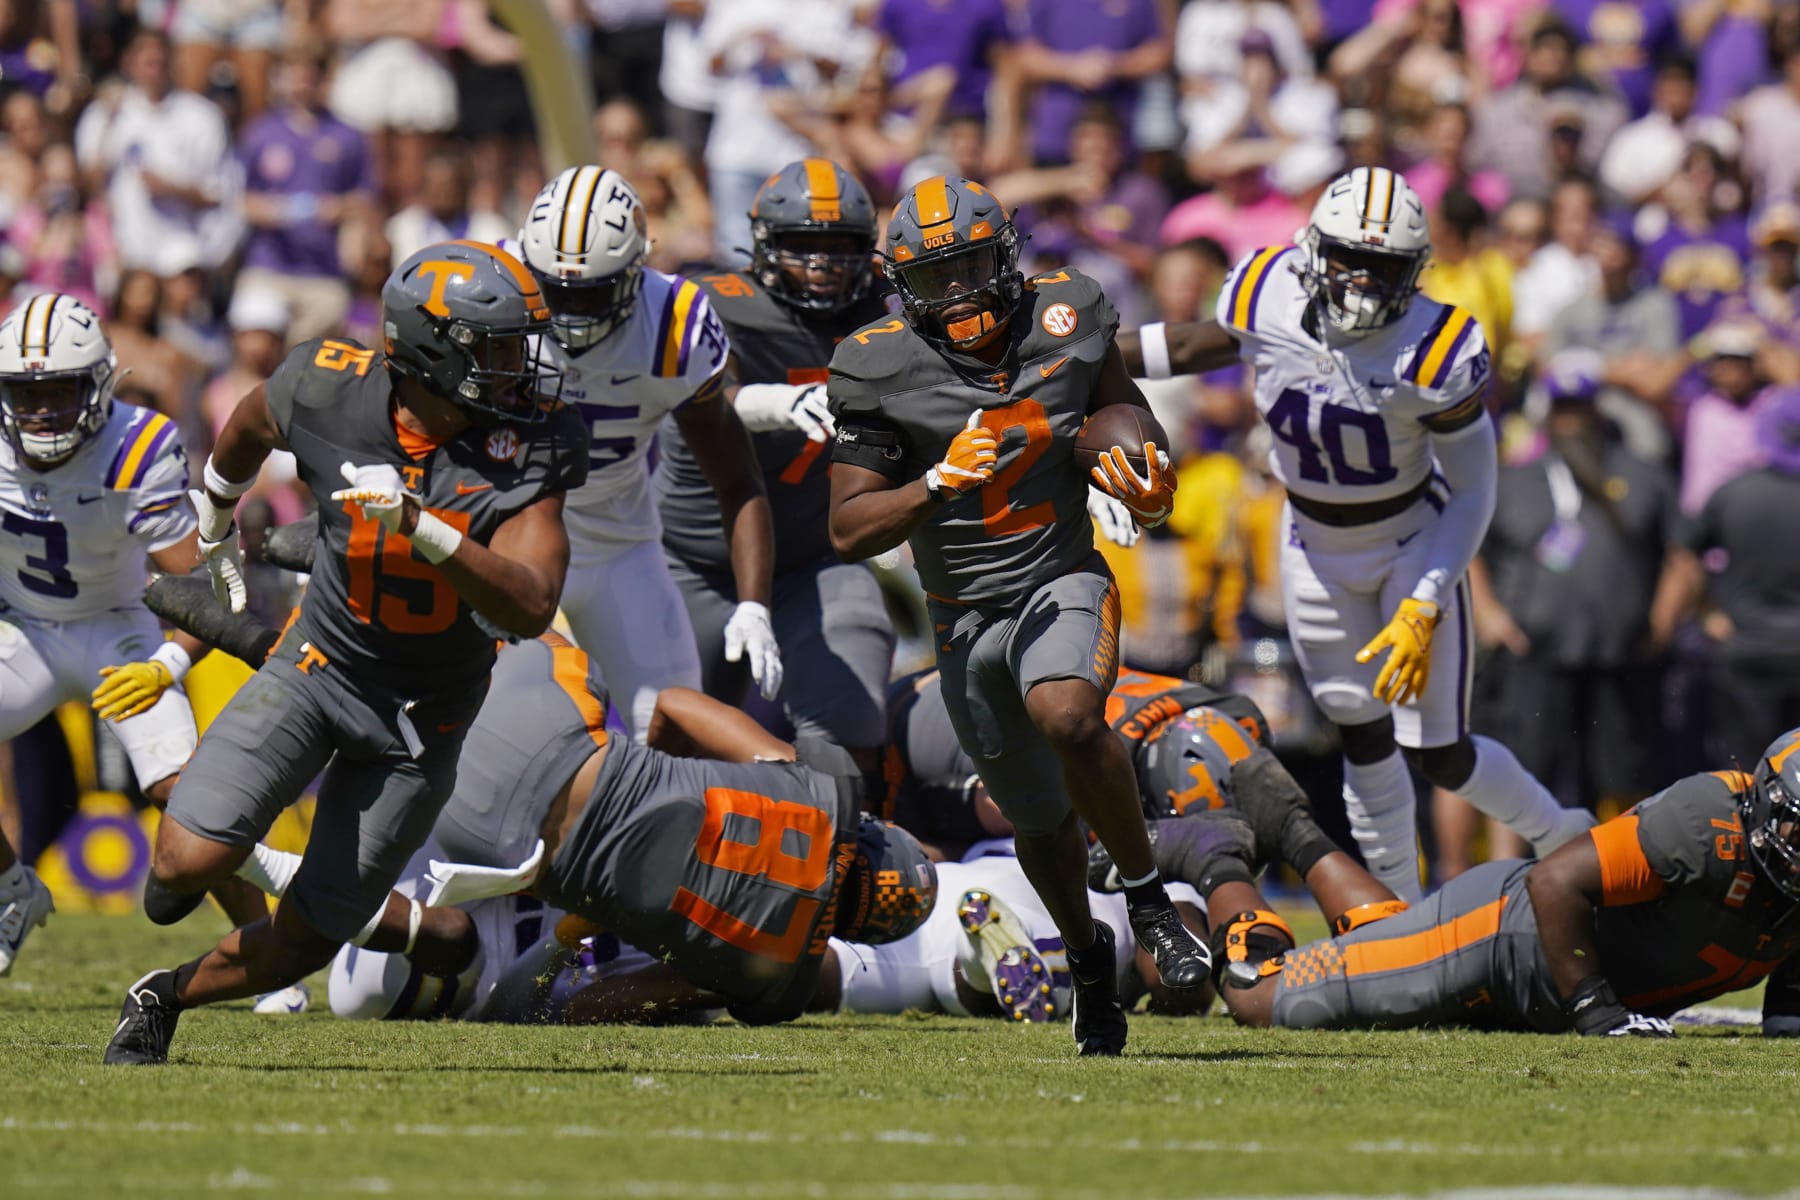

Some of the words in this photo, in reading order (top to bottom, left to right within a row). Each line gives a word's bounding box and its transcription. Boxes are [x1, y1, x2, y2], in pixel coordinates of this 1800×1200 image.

[923, 233, 955, 250] VOLS
[416, 260, 477, 318] T
[852, 319, 905, 345] 2
[1043, 305, 1078, 334] SEC
[312, 339, 376, 377] 15
[990, 372, 1009, 394] T
[487, 428, 518, 460] SEC
[1266, 387, 1399, 486] 40
[402, 465, 425, 490] T
[980, 397, 1058, 537] 2
[2, 510, 79, 599] 3
[342, 498, 471, 636] 15
[295, 641, 329, 676] T
[1166, 762, 1226, 817] T
[1710, 811, 1746, 861] 75
[670, 786, 834, 964] 87
